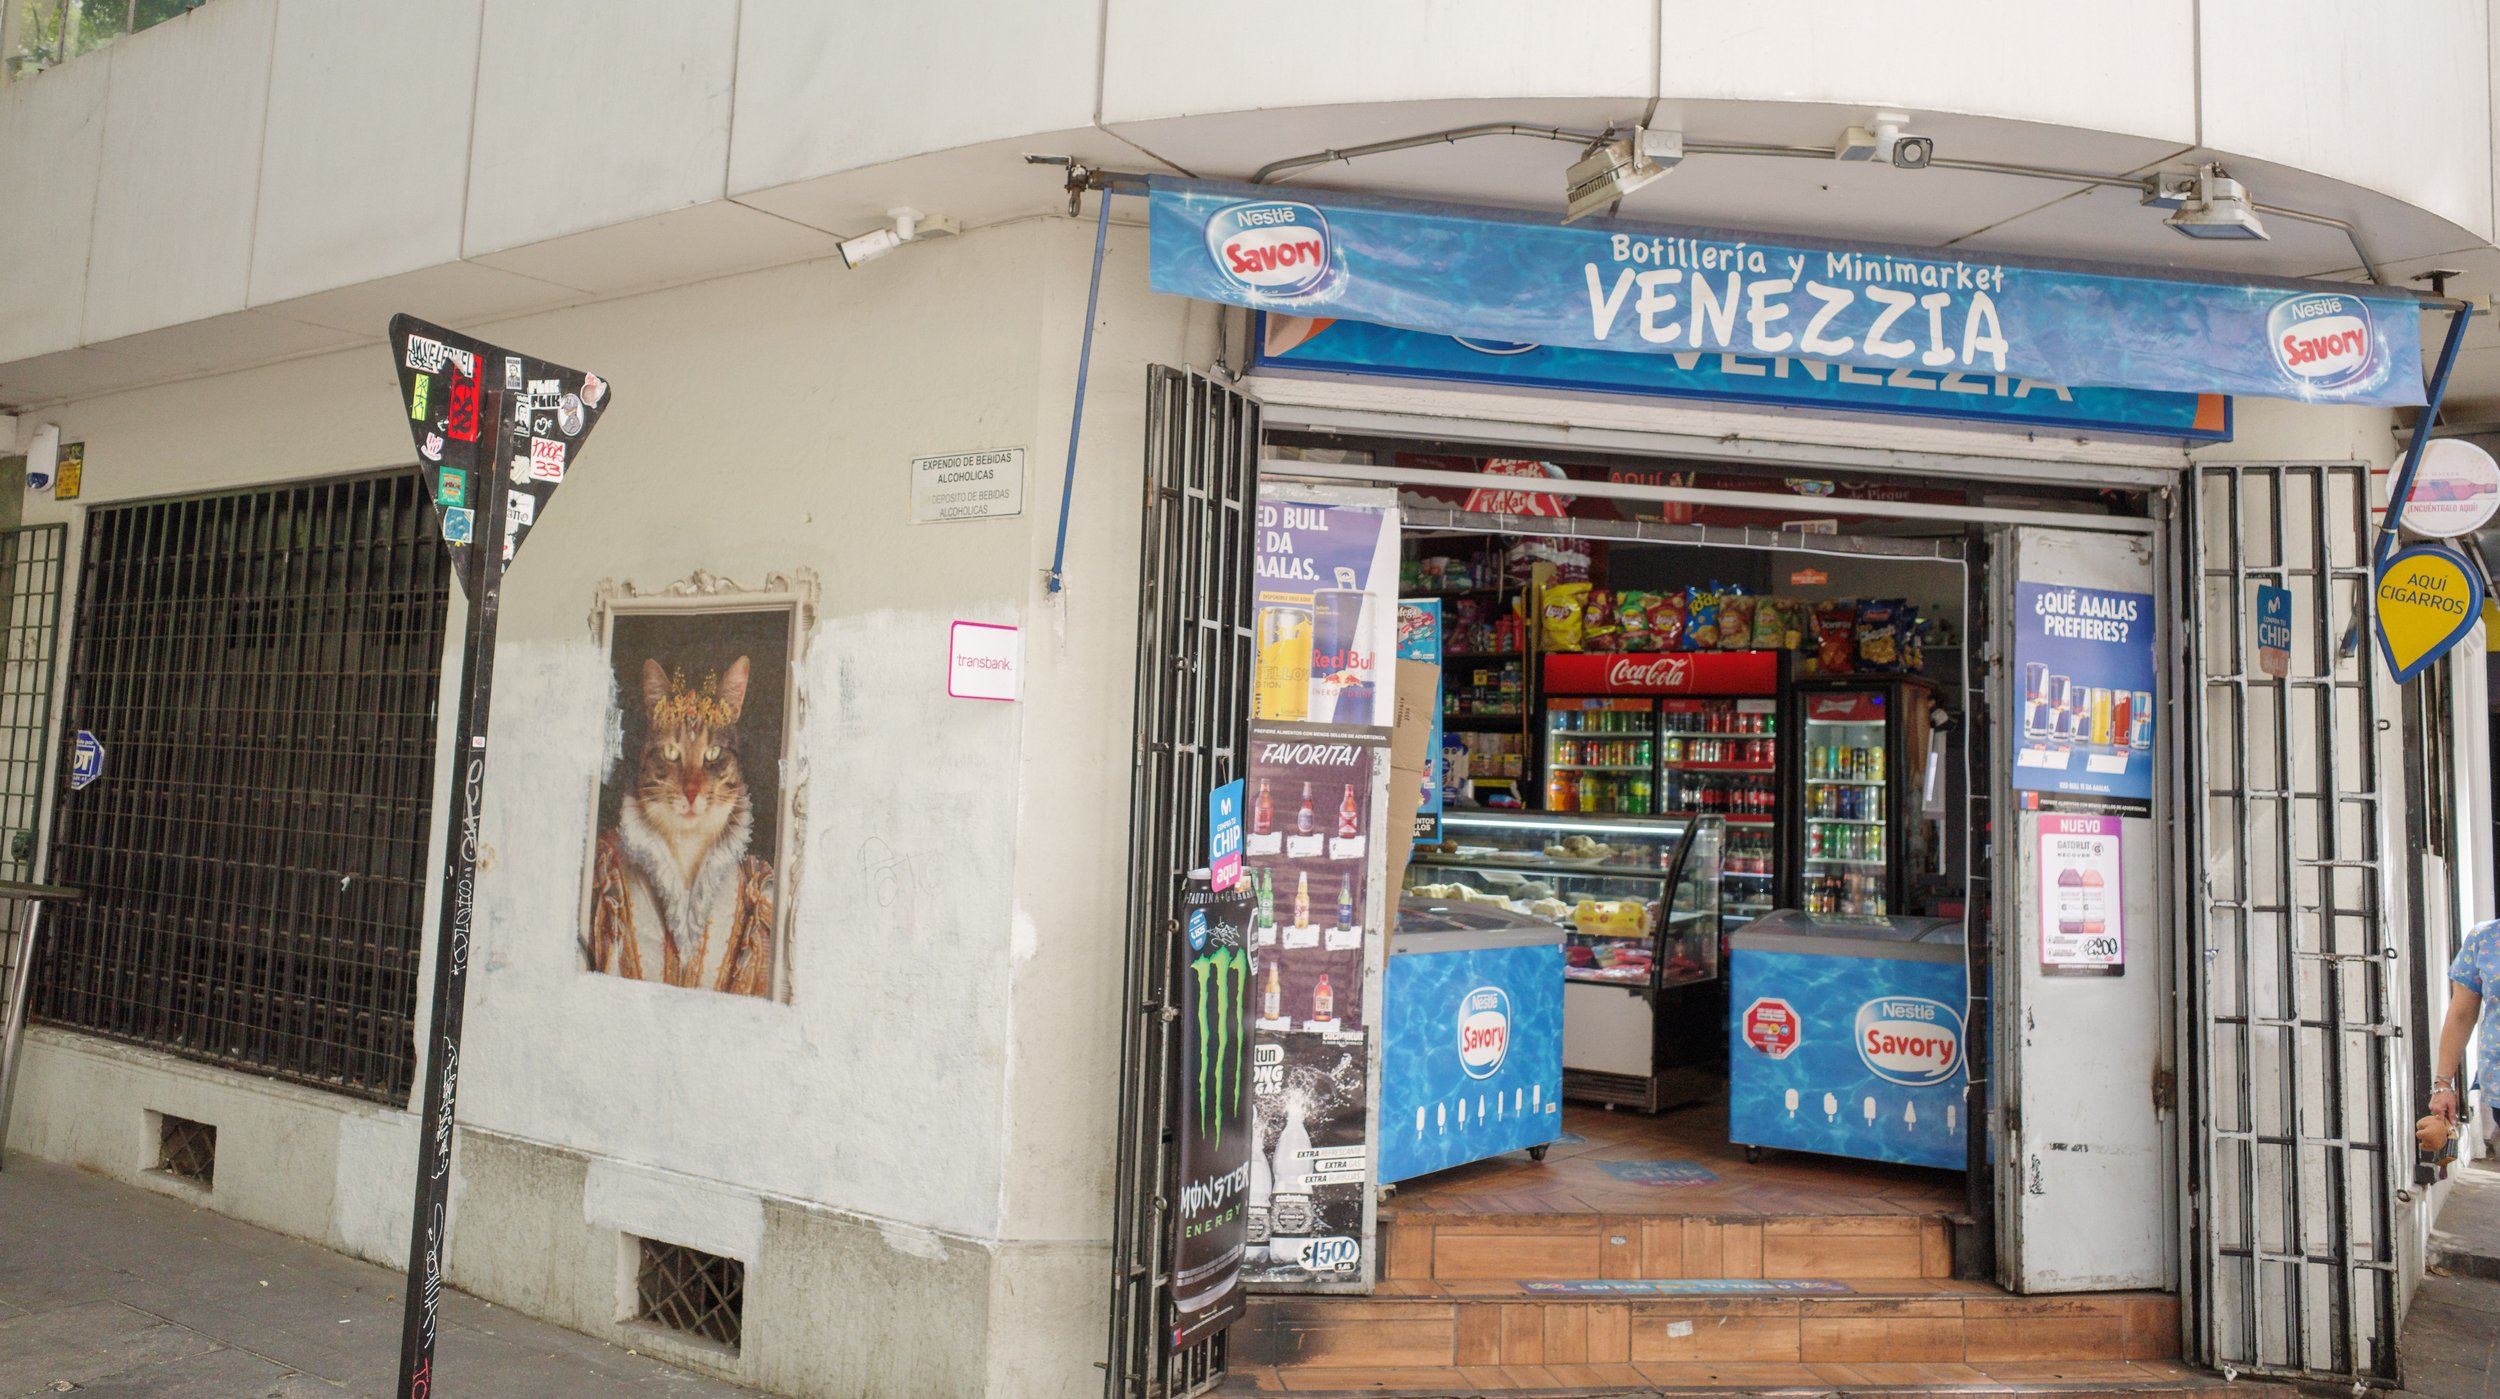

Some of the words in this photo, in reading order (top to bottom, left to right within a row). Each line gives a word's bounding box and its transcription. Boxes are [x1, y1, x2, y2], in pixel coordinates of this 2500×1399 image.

[1225, 239, 1321, 277] Savory
[1611, 234, 1766, 275] Botillería
[1787, 254, 1805, 284] y
[1826, 252, 2004, 294] Minimarket
[1584, 262, 2010, 372] VENEZZIA
[2283, 327, 2365, 367] Savory
[922, 457, 962, 471] EXPENDIO
[963, 456, 974, 467] DE
[976, 452, 1012, 466] BEBIDAS
[937, 469, 994, 484] ALCOHOLICAS
[931, 492, 967, 505] DEPOSITO
[967, 491, 977, 502] DE
[978, 488, 1010, 501] BEBIDAS
[939, 504, 988, 518] ALCOHOLICAS
[1283, 507, 1329, 532] BULL
[1266, 531, 1294, 554] DA
[2407, 573, 2449, 592] AQUÍ
[2035, 589, 2076, 616] ¿QUÉ
[2079, 595, 2138, 622] AAALAS
[2380, 585, 2465, 616] CIGARROS
[2044, 614, 2129, 644] PREFIERES?
[2259, 623, 2290, 649] CHIP
[1313, 649, 1344, 668] Red
[1347, 650, 1376, 671] Bull
[1260, 743, 1362, 767] FAVORITA!
[2060, 819, 2101, 833] NUEVO
[1213, 824, 1241, 858] CHIP
[2057, 840, 2090, 850] GATORLIT
[1216, 853, 1239, 886] aquí
[1463, 1025, 1505, 1053] Savory
[1866, 1029, 1954, 1066] Savory
[1297, 1150, 1320, 1159] EXTRA
[1325, 1160, 1347, 1169] EXTRA
[1305, 1175, 1327, 1184] EXTRA
[1185, 1202, 1242, 1239] ENERGY
